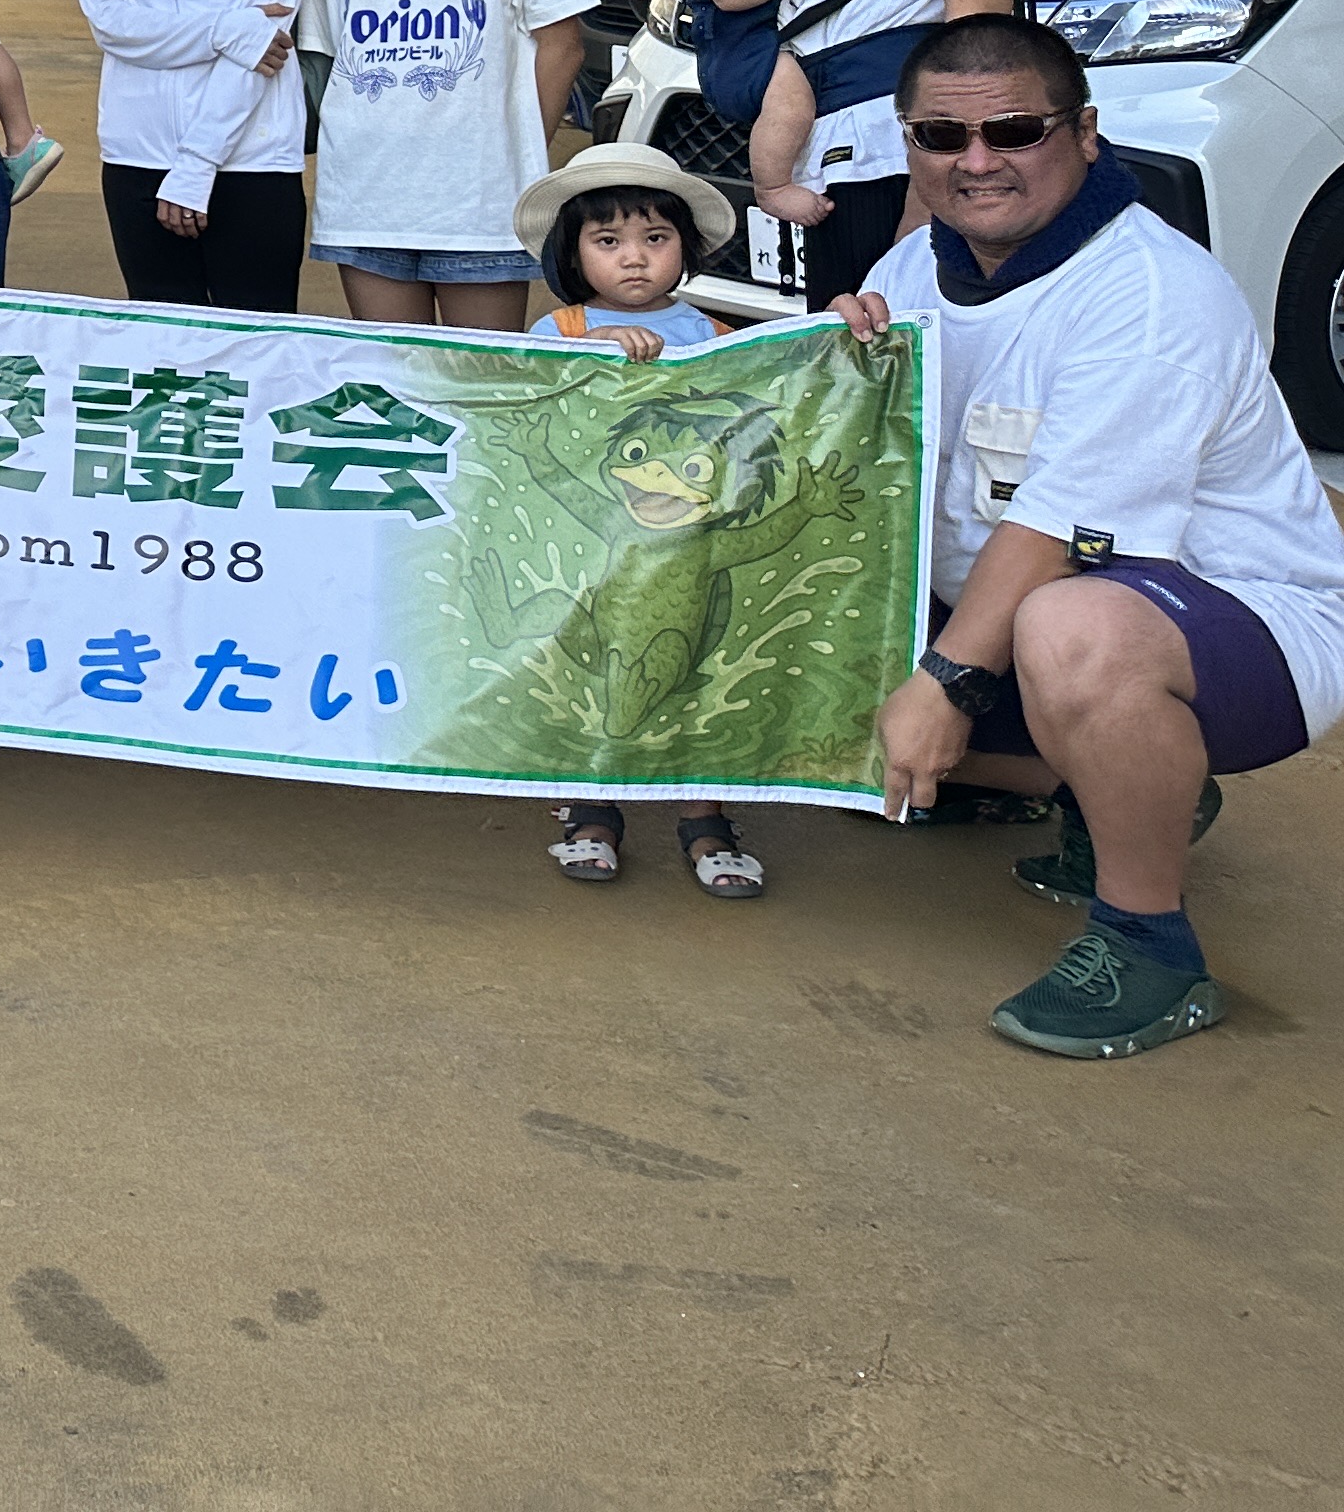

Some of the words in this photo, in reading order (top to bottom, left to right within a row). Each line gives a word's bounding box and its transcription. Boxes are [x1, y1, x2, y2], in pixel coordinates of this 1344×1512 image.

[364, 45, 444, 64] オリオンビール
[757, 248, 772, 266] れ
